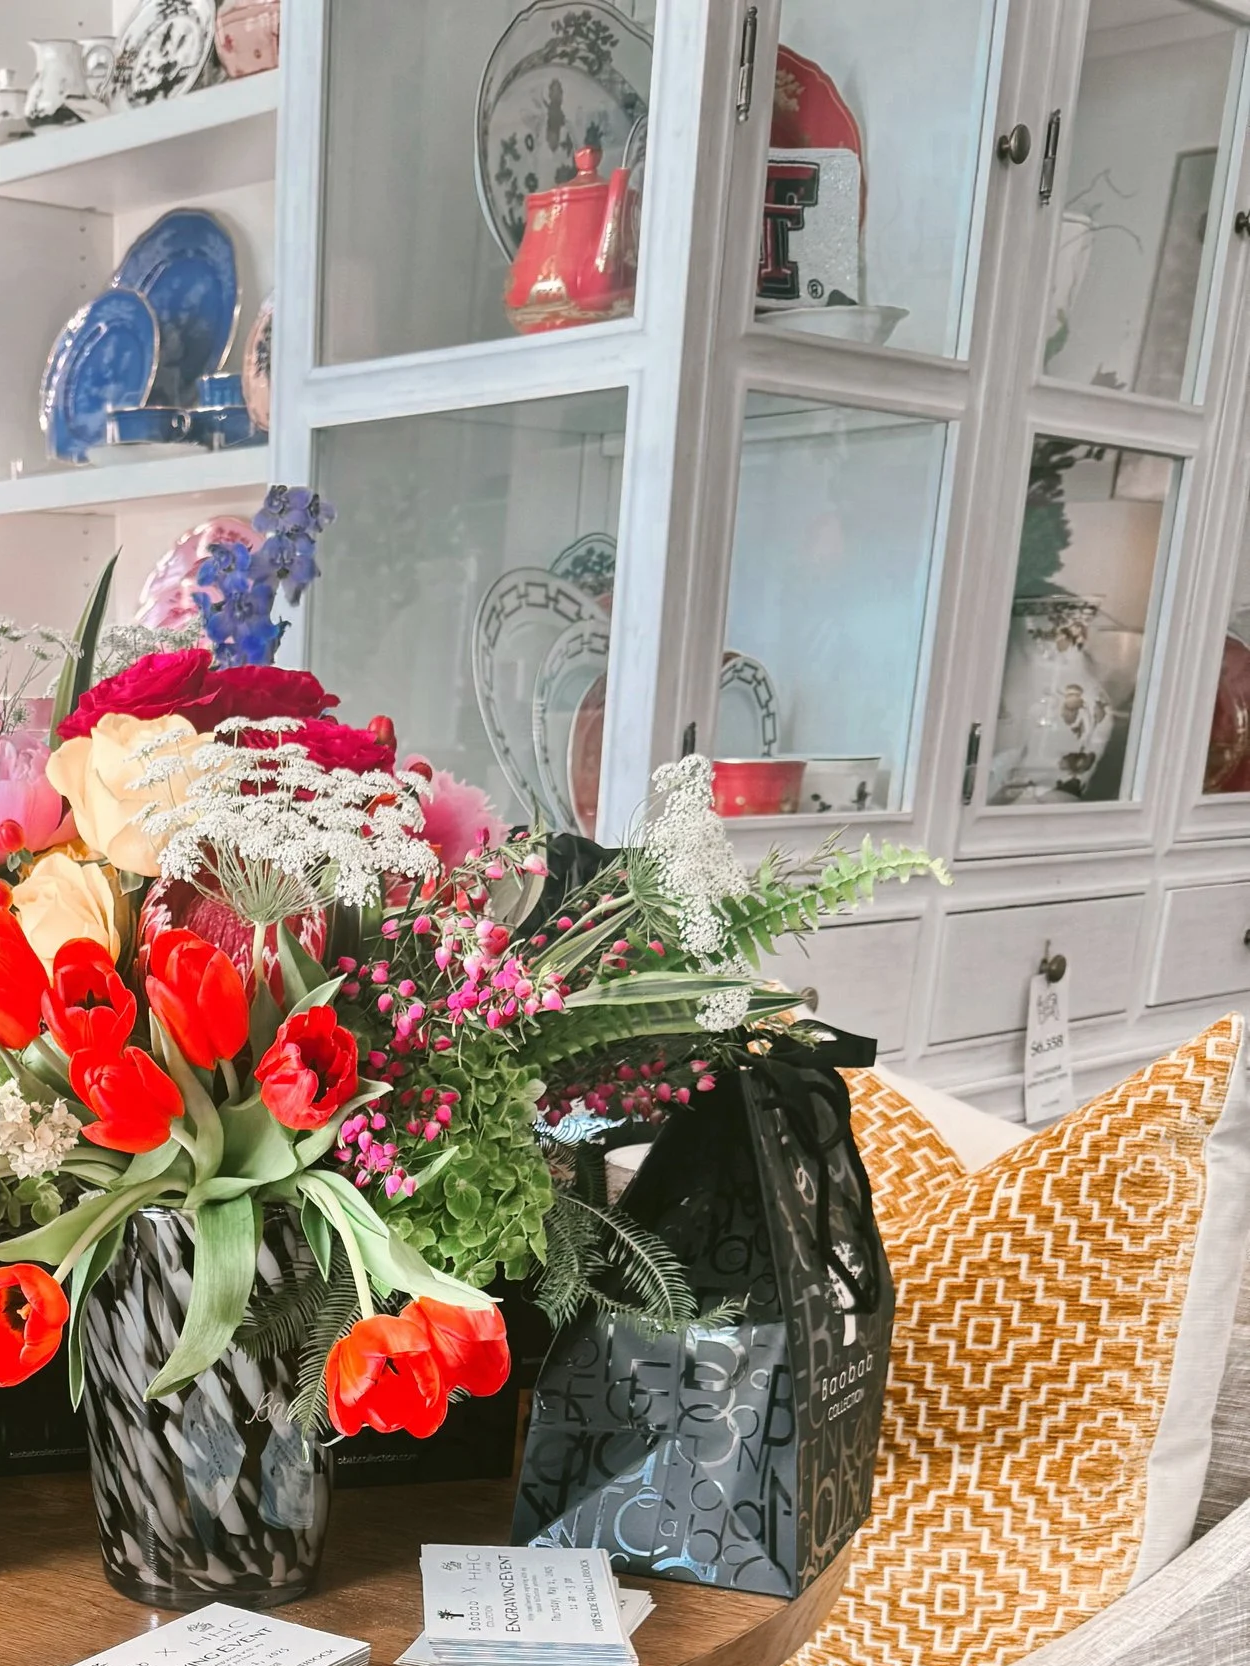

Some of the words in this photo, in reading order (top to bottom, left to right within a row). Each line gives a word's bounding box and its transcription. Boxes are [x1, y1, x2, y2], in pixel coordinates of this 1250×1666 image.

[821, 1351, 874, 1402] Baobab
[466, 1553, 482, 1581] HHC
[498, 1555, 514, 1581] EVENT
[468, 1600, 481, 1632] Baobab
[500, 1580, 521, 1632] ENGRAVING
[189, 1619, 250, 1647] HHC
[217, 1626, 273, 1654] EVENT
